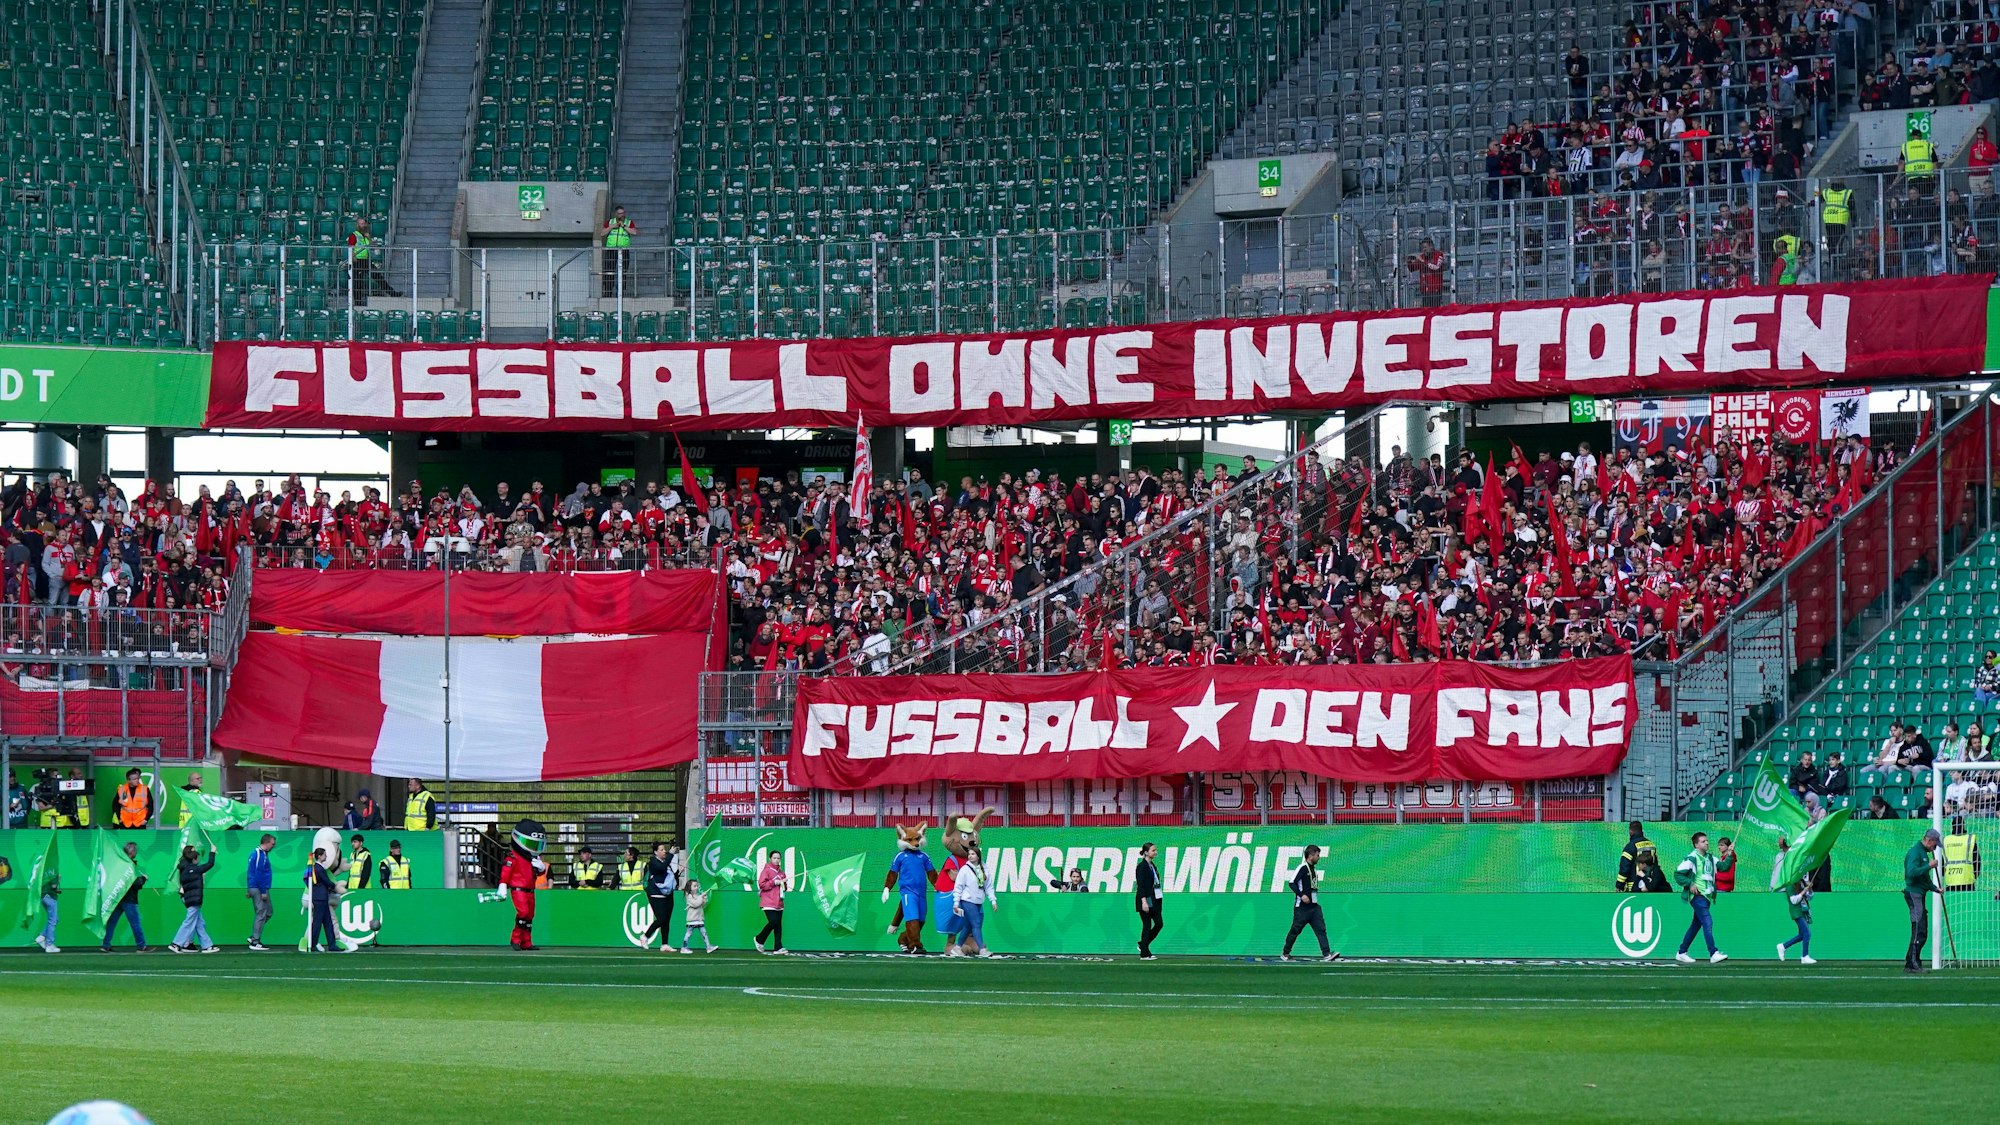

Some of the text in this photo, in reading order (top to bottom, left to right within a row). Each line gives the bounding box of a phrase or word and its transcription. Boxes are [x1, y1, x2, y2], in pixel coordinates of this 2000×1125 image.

[1909, 118, 1930, 133] 36
[1260, 166, 1280, 181] 34
[521, 190, 544, 204] 32
[244, 293, 1851, 420] FUSSBALL OHNE INVESTOREN
[0, 367, 55, 402] DT
[1572, 400, 1594, 416] 35
[1713, 391, 1770, 411] FUSS
[1779, 396, 1813, 414] VIDEOBEWEIS
[1675, 412, 1709, 440] 97
[1713, 411, 1769, 429] BALL
[1111, 423, 1131, 439] 33
[804, 444, 852, 459] DRINKS
[802, 682, 1629, 760] FUSSBALL DEN FANS
